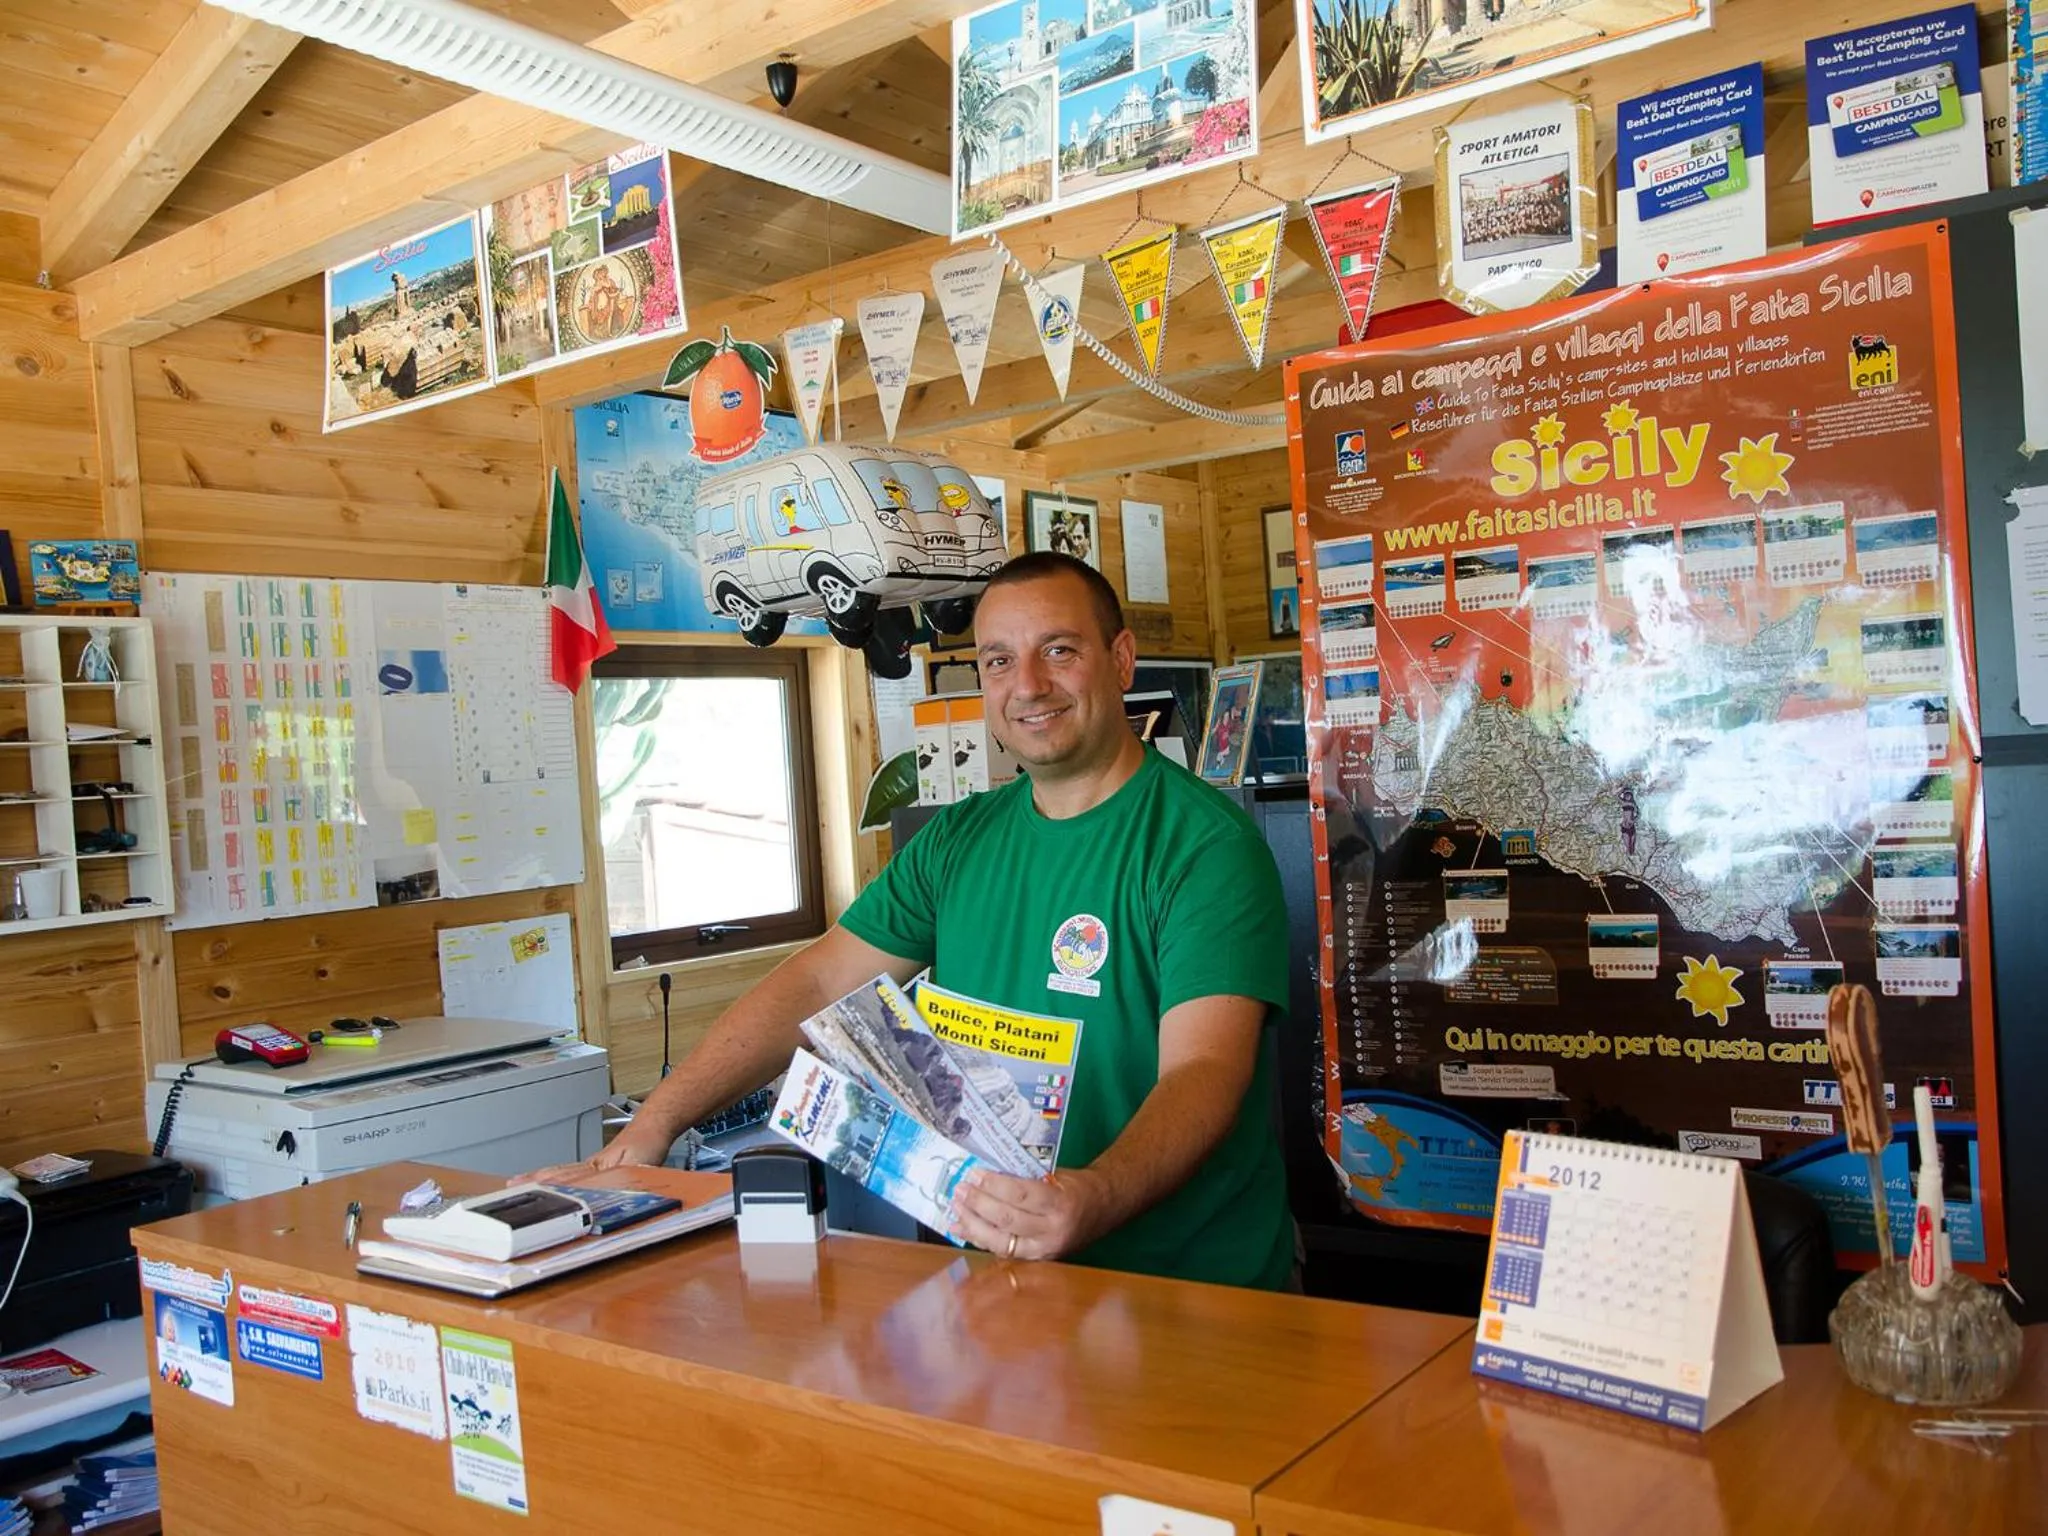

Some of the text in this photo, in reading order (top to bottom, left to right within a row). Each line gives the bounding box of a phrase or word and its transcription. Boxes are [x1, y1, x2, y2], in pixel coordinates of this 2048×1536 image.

[1817, 25, 1965, 66] Best Deal Camping Card
[1833, 20, 1946, 51] Wij accepteren uw
[1627, 85, 1752, 129] Best Deal Camping Card
[1641, 81, 1737, 115] Wij accepteren uw
[1459, 123, 1562, 156] SPORT AMATORI
[1481, 145, 1539, 165] ATLETICA
[1310, 264, 1912, 410] Guida ai campeggi e villaggi della Faita Sicilia
[1437, 333, 1790, 409] Guide To Faita Sicily's camp-sites and holiday villages
[1856, 362, 1892, 387] eni
[1481, 404, 1499, 423] für
[1502, 399, 1520, 417] die
[1524, 395, 1557, 417] Faita
[1561, 386, 1603, 408] Sizilien
[1607, 371, 1702, 401] Campingplätze
[1707, 363, 1731, 380] und
[1490, 408, 1711, 497] Sicily
[1384, 488, 1657, 552] www.faitasicilia.it
[924, 535, 966, 547] HYMER
[928, 1001, 988, 1031] Belice,
[994, 1020, 1060, 1043] Platani
[934, 1023, 1047, 1060] Monti Sicani
[1445, 1026, 1484, 1053] Qui
[1485, 1028, 1509, 1051] in
[1510, 1030, 1612, 1059] omaggio
[1613, 1035, 1653, 1060] per
[1653, 1034, 1682, 1057] te
[1684, 1038, 1765, 1063] questa
[343, 1127, 390, 1145] SHARP
[1549, 1164, 1602, 1191] 2012
[378, 1378, 431, 1413] Parks.it
